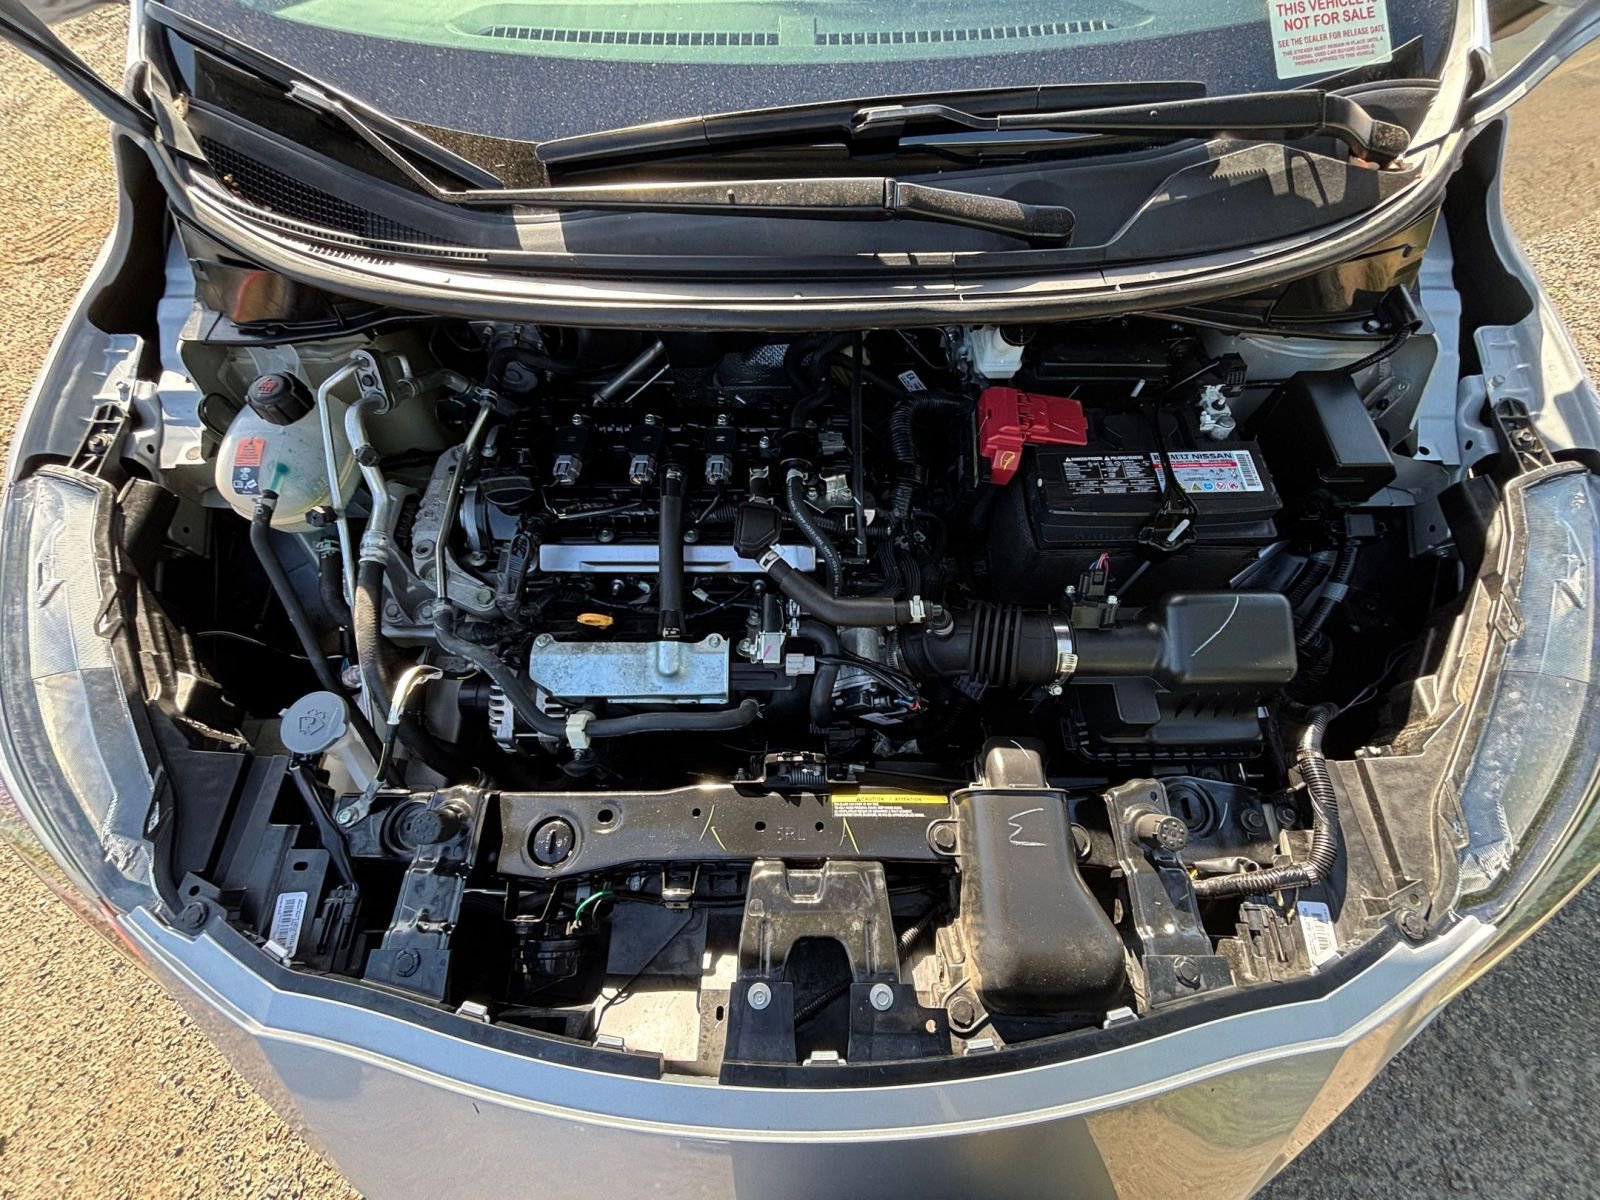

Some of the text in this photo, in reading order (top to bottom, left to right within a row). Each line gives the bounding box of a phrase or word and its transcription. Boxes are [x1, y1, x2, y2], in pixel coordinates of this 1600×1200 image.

[1276, 2, 1306, 16] THIS
[1284, 6, 1376, 32] NOT FOR SALE
[1278, 24, 1385, 48] SEE THE DEALER FOR RELEASE DATE
